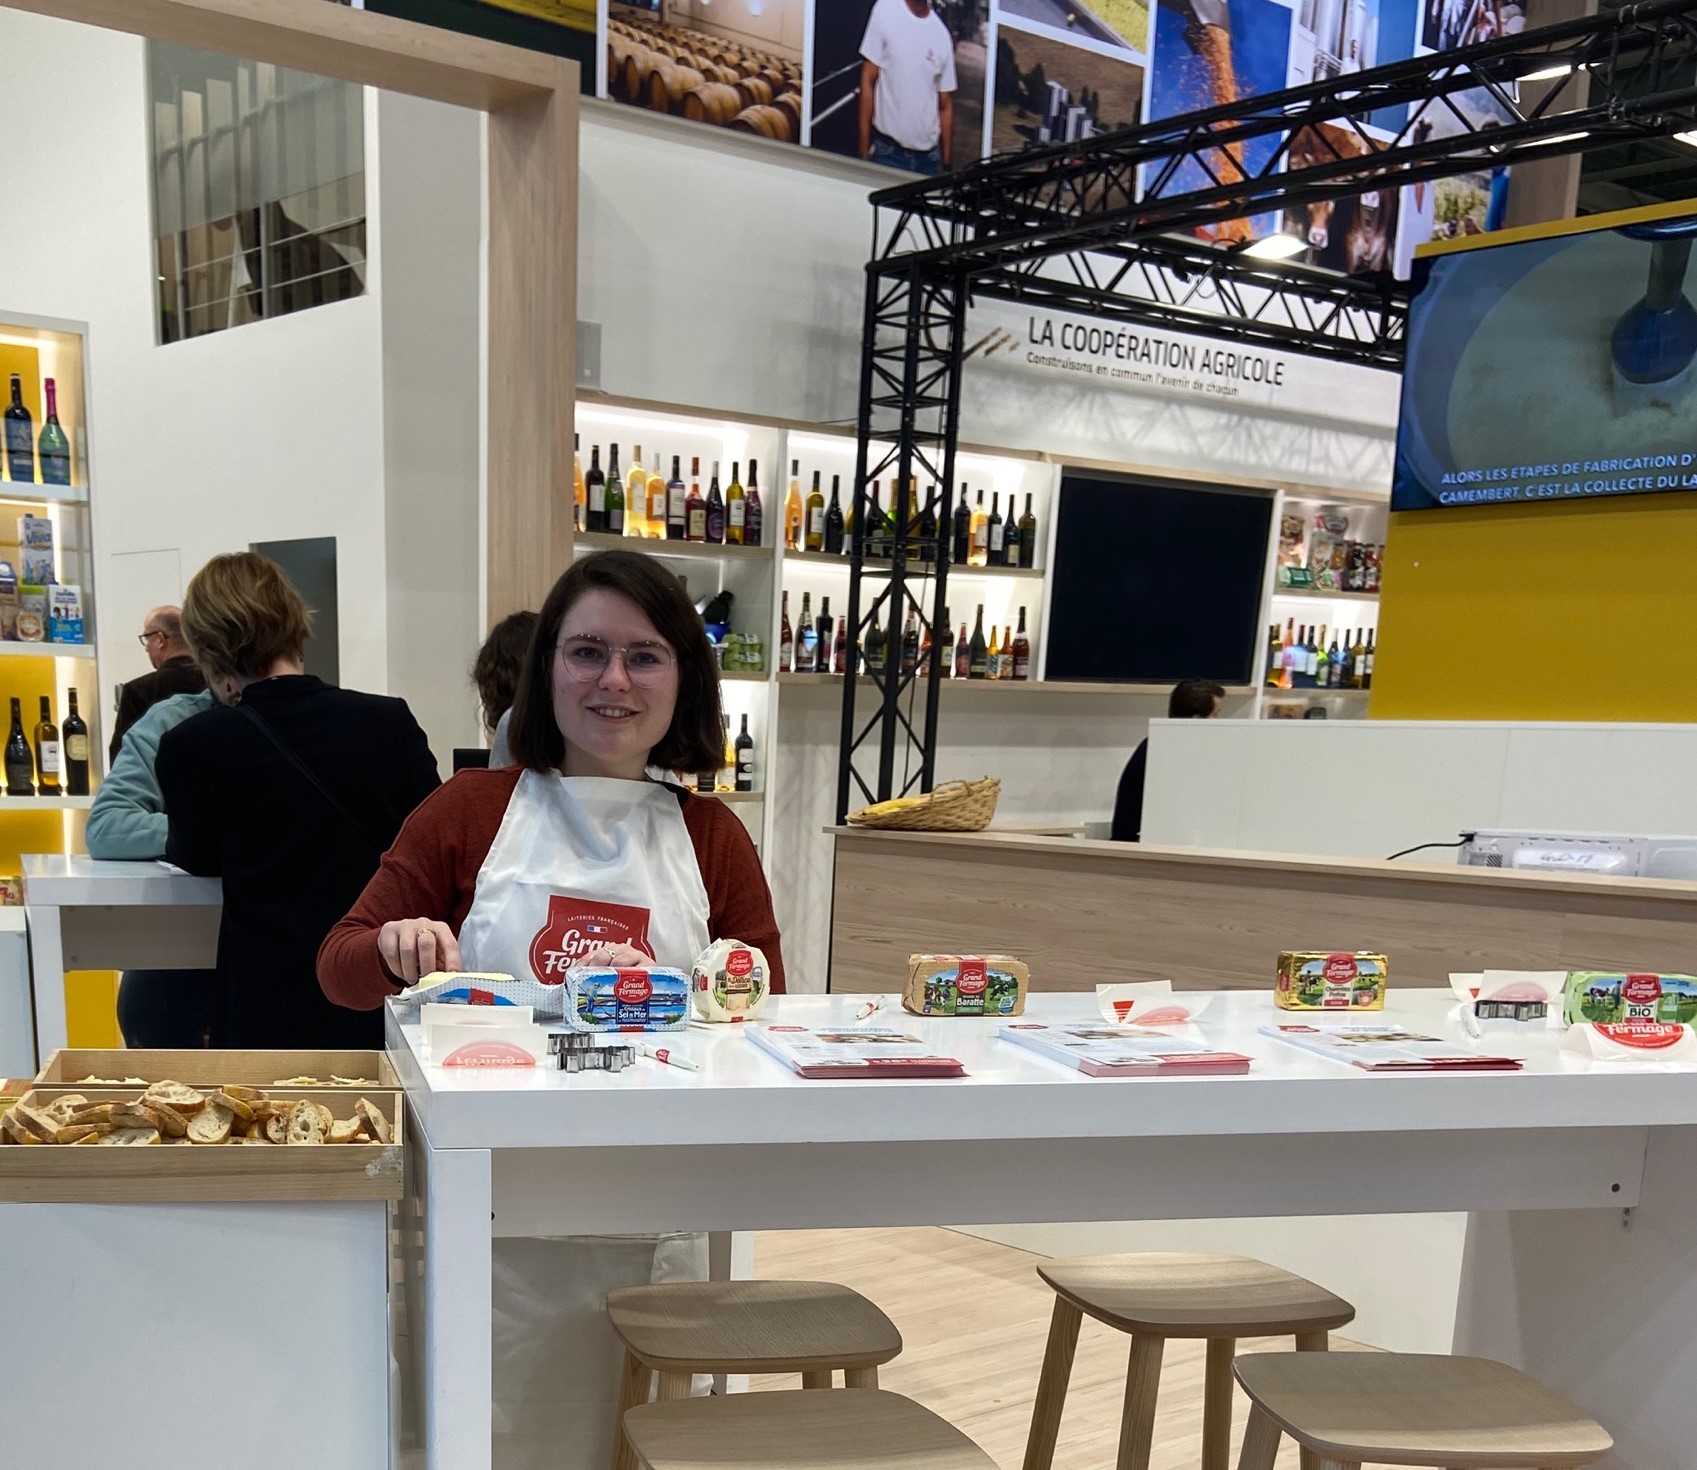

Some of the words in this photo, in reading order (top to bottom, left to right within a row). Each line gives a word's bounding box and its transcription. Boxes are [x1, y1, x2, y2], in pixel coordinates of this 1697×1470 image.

[1030, 316, 1055, 348] LA
[1060, 323, 1196, 371] COOPÉRATION
[1199, 348, 1285, 386] AGRICOLE
[1026, 351, 1093, 374] Construisons
[1096, 365, 1109, 376] en
[1111, 368, 1152, 382] commun
[1441, 470, 1483, 485] ALORS
[1486, 467, 1508, 481] LES
[1511, 463, 1559, 479] ETAPES
[1562, 461, 1580, 475] DE
[1583, 454, 1677, 473] FABRICATION
[1525, 483, 1561, 497] C'EST
[1564, 482, 1580, 495] LA
[1584, 476, 1653, 493] COLLECTE
[1657, 475, 1679, 488] DU
[963, 973, 983, 981] Grand
[623, 980, 645, 989] Grand
[958, 980, 986, 988] Fermage
[1631, 982, 1655, 990] Grand
[618, 987, 649, 997] Fermage
[1627, 989, 1658, 997] Fermage
[956, 997, 984, 1006] Baratte
[618, 1010, 629, 1018] Sel
[1606, 1023, 1673, 1037] Fermage
